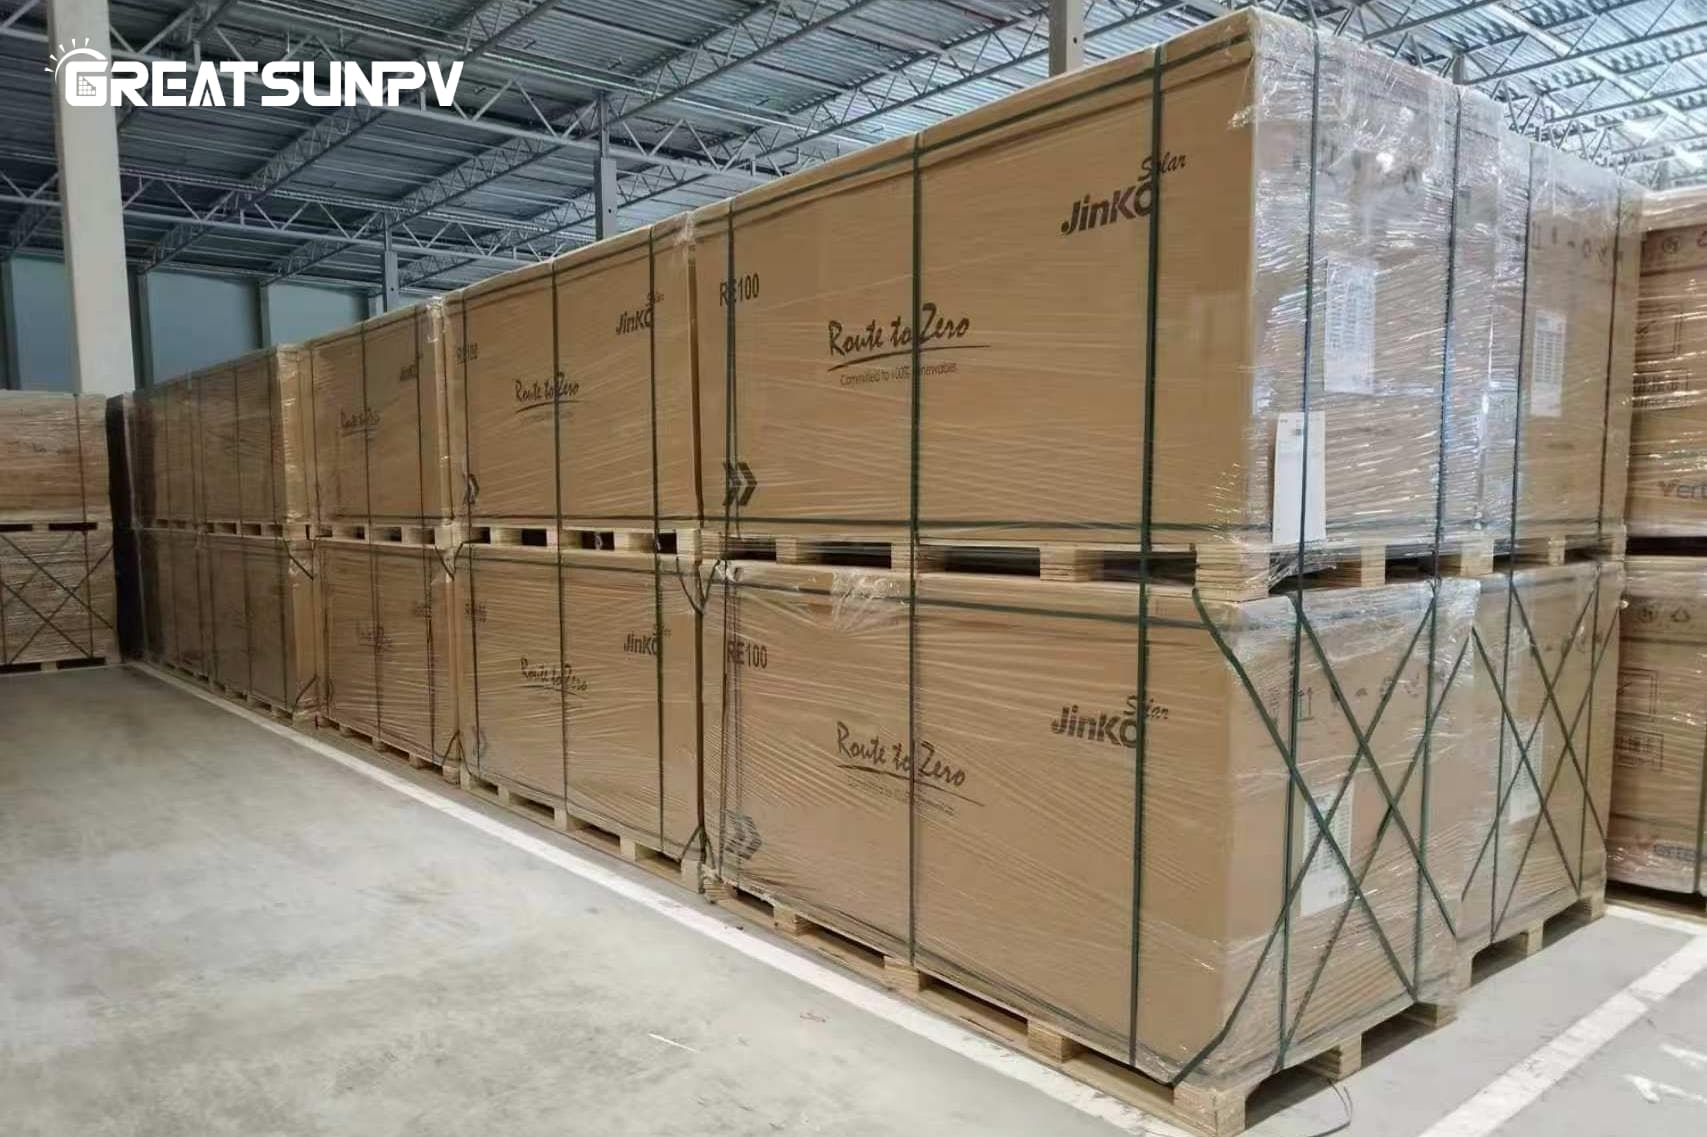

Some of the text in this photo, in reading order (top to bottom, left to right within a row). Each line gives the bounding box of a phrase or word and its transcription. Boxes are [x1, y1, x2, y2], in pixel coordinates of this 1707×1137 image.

[1137, 151, 1187, 182] Slar
[828, 301, 971, 357] Route to Zero
[836, 720, 887, 765] Route
[917, 739, 967, 787] Zero
